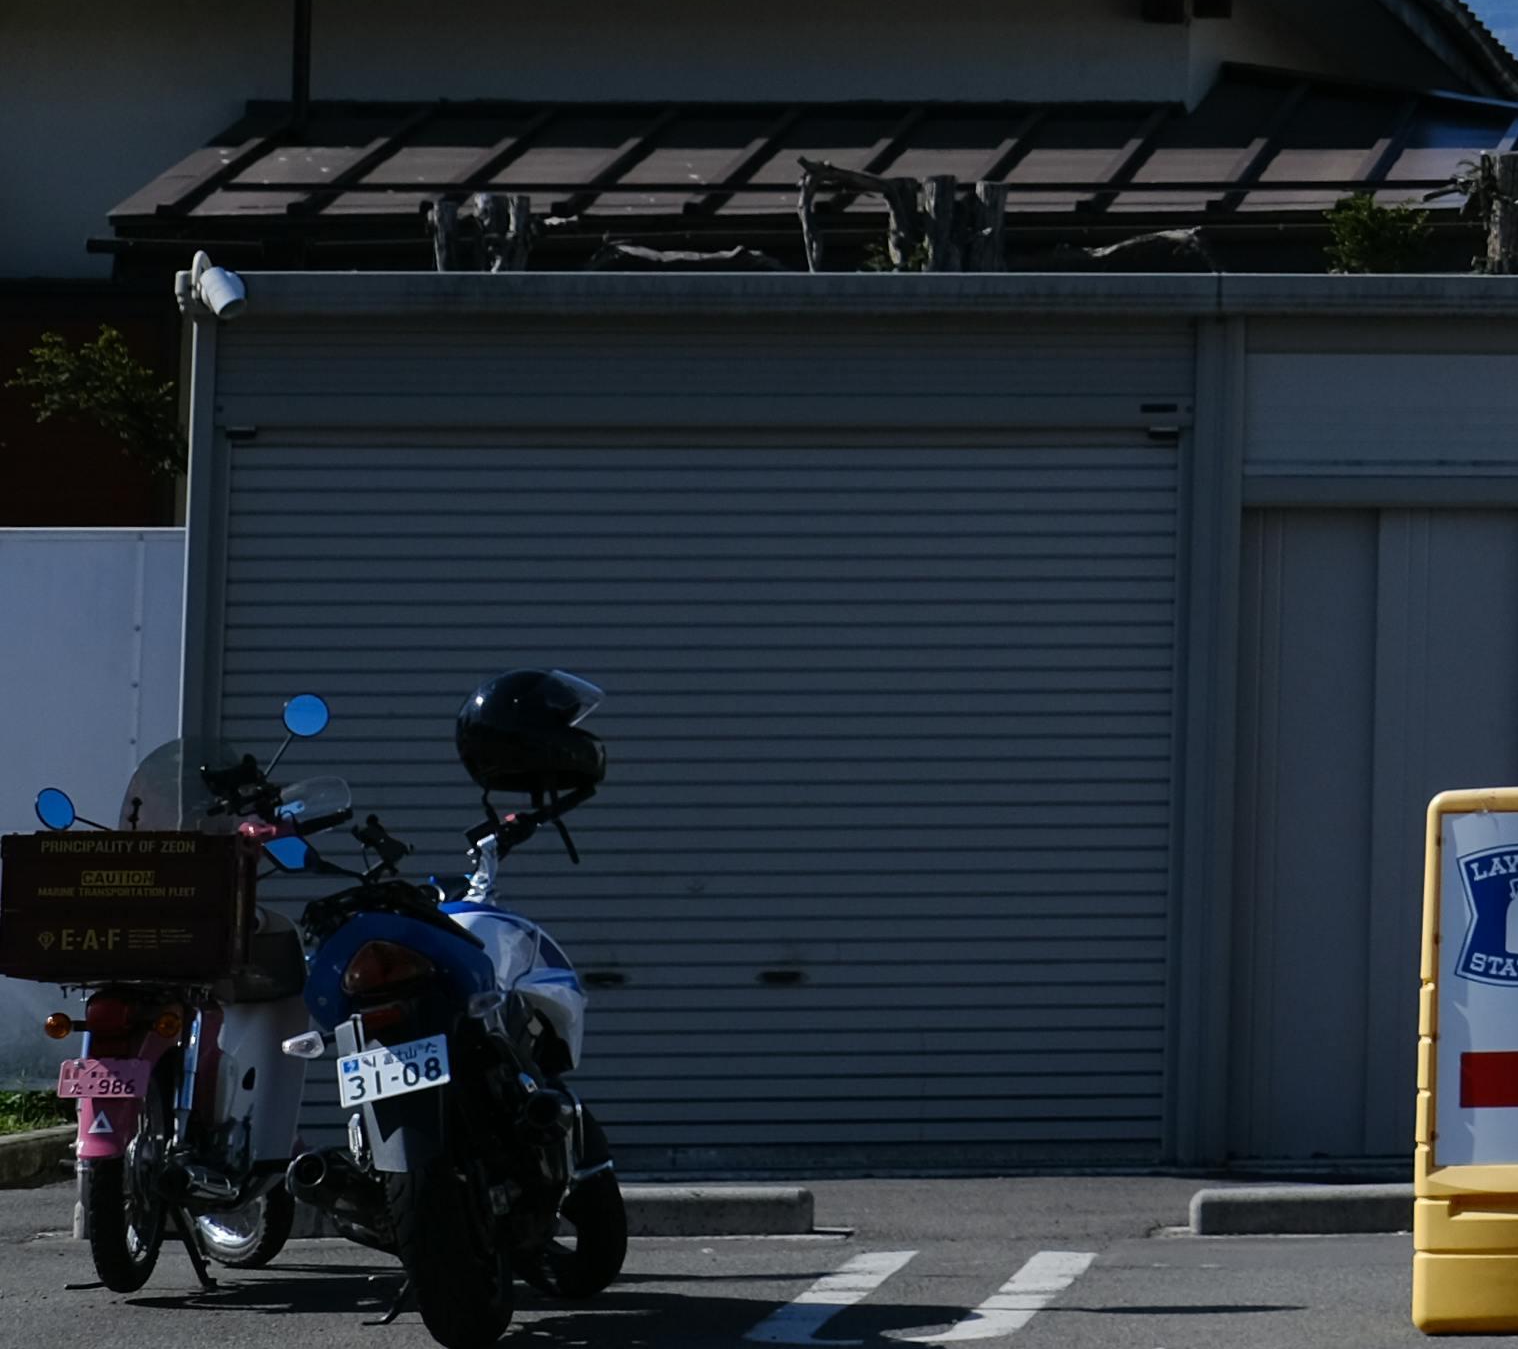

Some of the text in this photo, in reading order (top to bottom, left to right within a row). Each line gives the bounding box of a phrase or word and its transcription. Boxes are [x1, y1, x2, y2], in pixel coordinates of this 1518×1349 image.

[40, 839, 197, 854] PRINCIPALITY OF ZEON
[82, 870, 155, 886] CAUTION
[38, 887, 196, 898] MARINE TRANSPORTATION FLEET
[348, 1056, 442, 1101] 31-08
